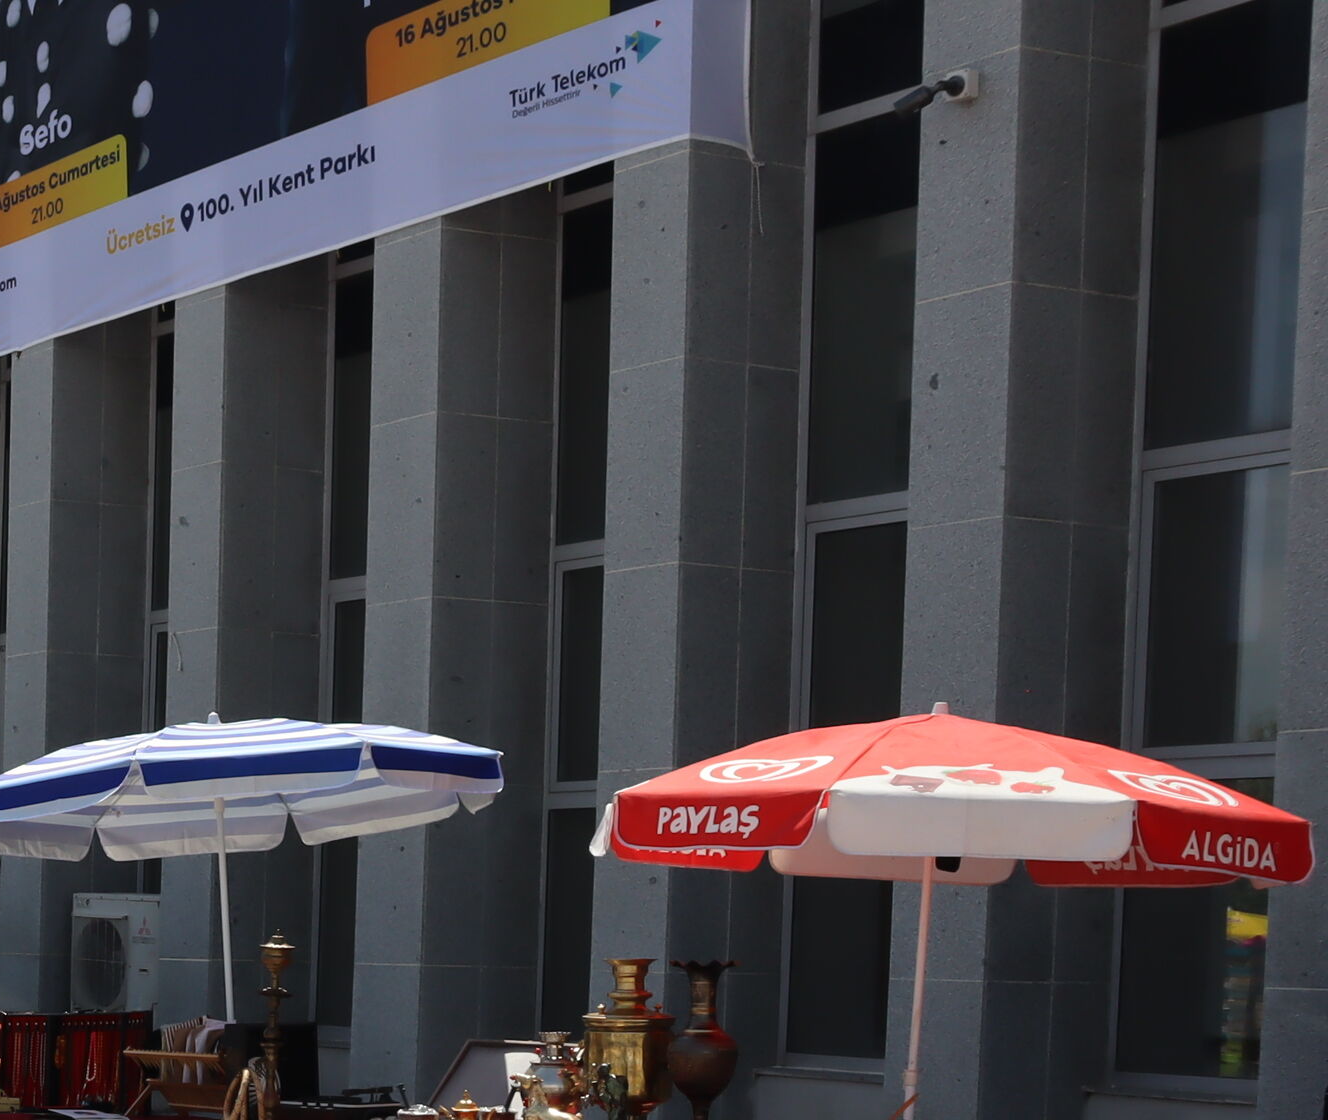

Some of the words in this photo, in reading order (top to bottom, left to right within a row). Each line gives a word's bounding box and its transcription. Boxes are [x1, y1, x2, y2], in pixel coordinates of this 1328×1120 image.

[395, 24, 416, 48] 16
[456, 22, 507, 58] 21.00
[509, 86, 546, 108] Türk
[551, 55, 626, 93] Telekom
[48, 144, 121, 189] Cumartesi
[31, 197, 64, 225] 21.00
[106, 214, 176, 254] Ücretsiz
[197, 192, 235, 222] 100.
[238, 179, 263, 207] Yıl
[269, 164, 315, 198] Kent
[320, 144, 376, 180] Parkı
